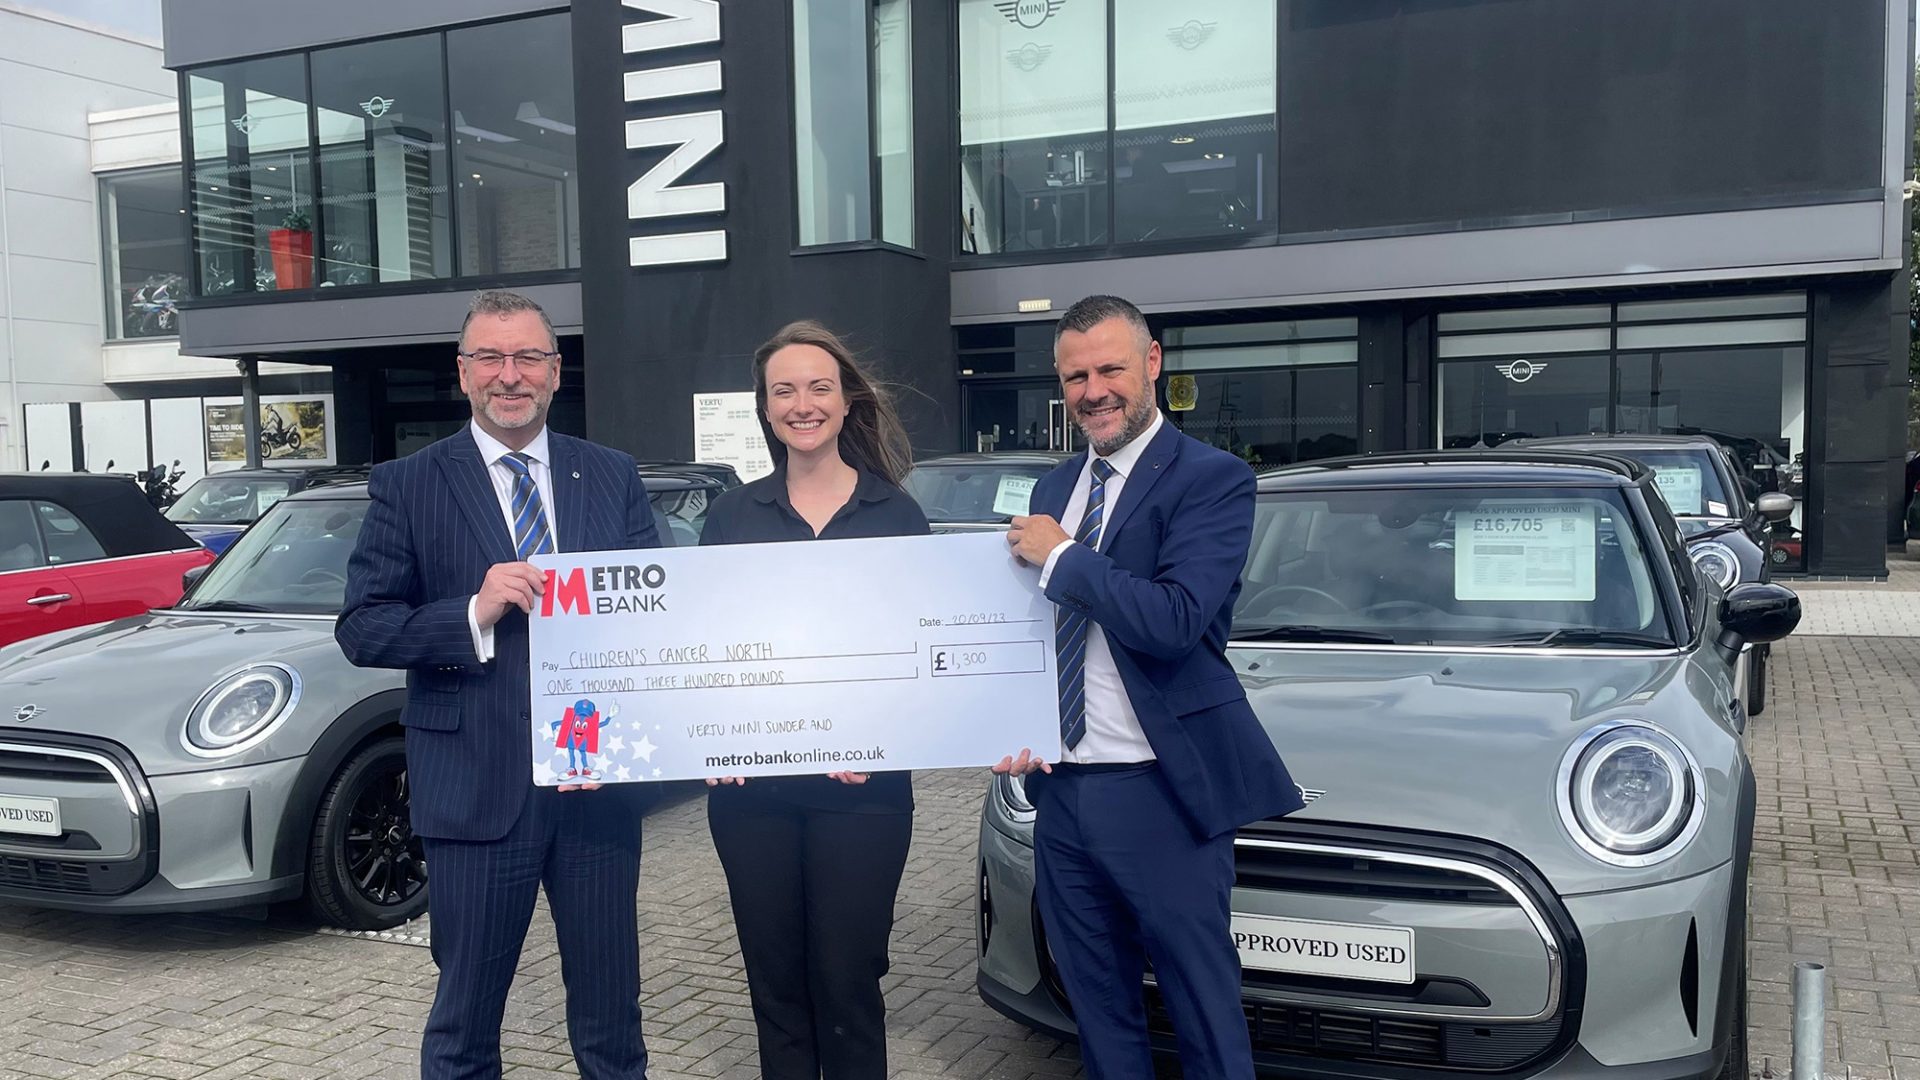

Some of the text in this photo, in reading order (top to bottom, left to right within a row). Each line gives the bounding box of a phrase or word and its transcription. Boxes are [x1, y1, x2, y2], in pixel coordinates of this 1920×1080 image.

[1019, 4, 1046, 16] MINI
[1473, 518, 1544, 533] £16,705
[541, 563, 666, 617] METRO
[596, 593, 667, 615] BANK
[919, 618, 945, 627] Date:
[569, 642, 773, 669] CHILDREN'S CANCER NORTH
[542, 662, 559, 672] Pay
[547, 670, 785, 695] ONE THOUSAND THREE HUNDRED POUNDS
[687, 723, 726, 738] VERTU
[731, 721, 761, 736] MINI
[705, 746, 886, 767] metrobankonline.co.uk
[25, 809, 54, 823] USED
[1345, 943, 1406, 965] USED
